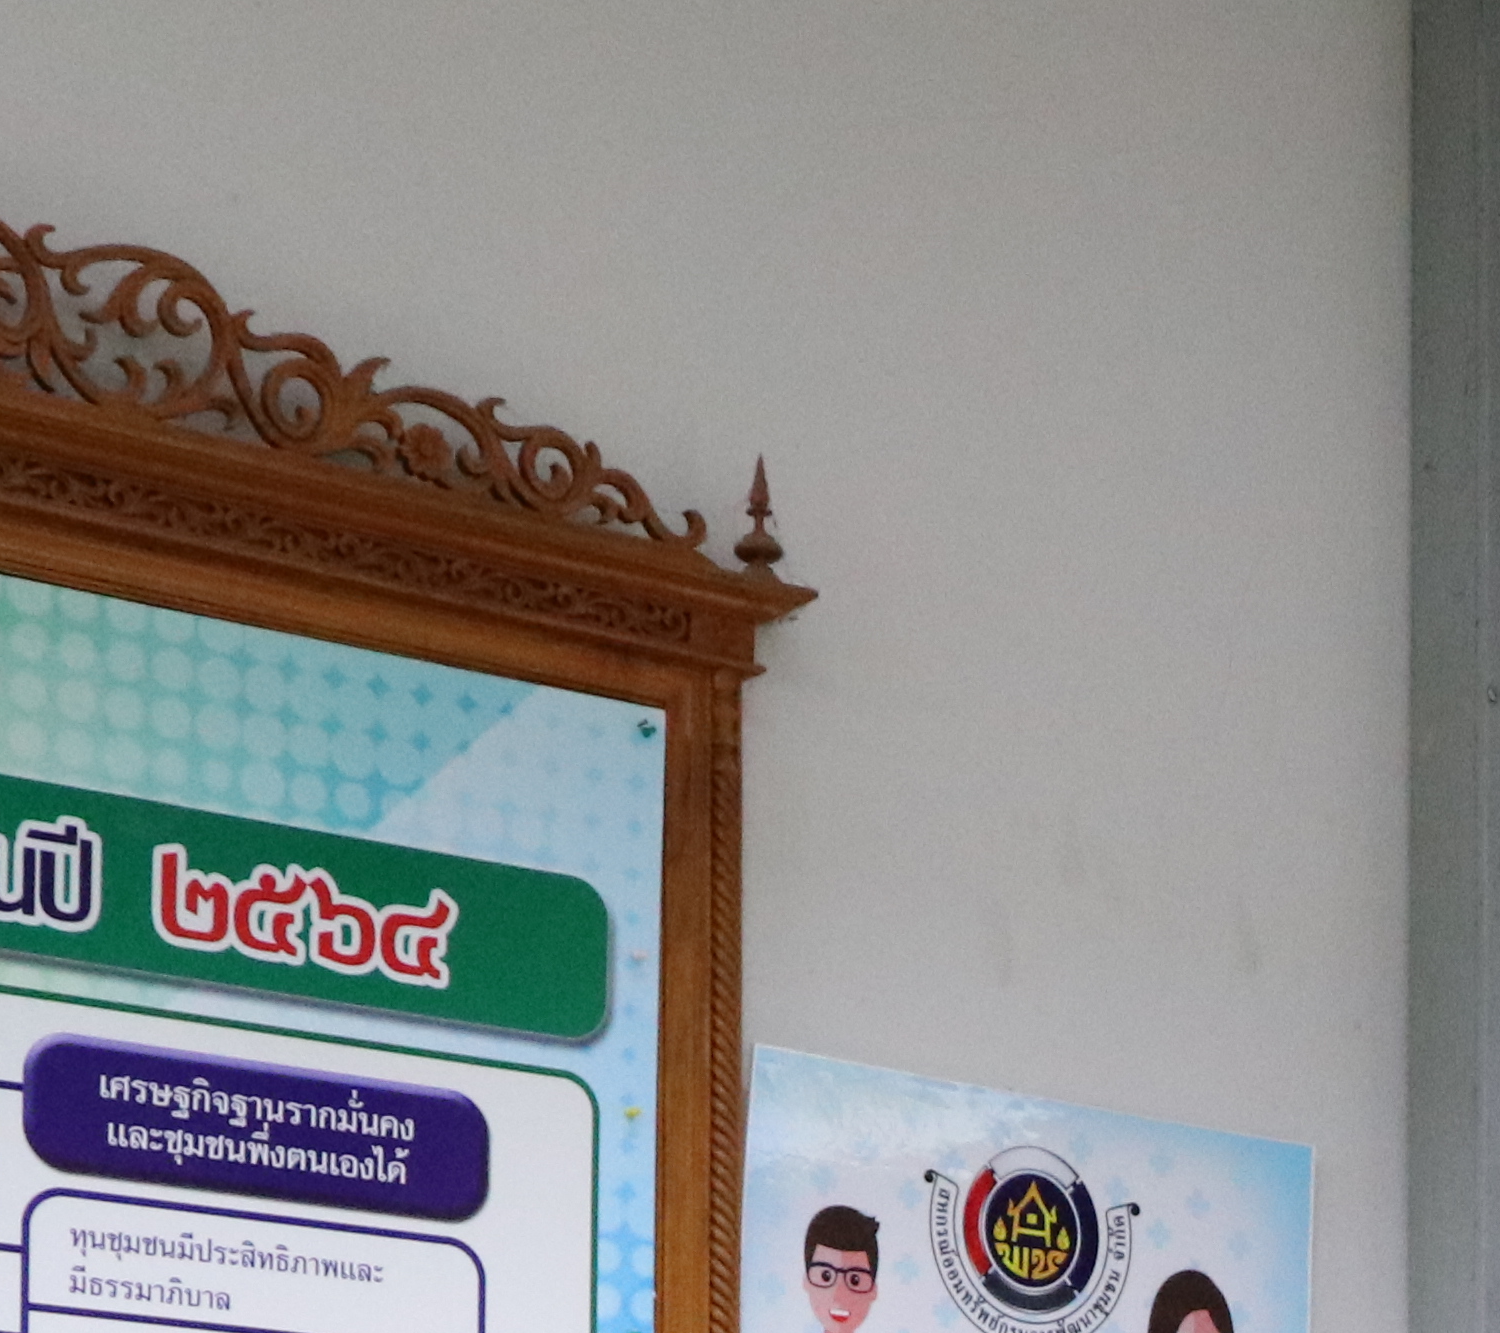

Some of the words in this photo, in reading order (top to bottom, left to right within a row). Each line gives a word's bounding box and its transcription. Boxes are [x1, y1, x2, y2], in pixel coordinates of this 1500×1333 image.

[160, 852, 451, 980] ๒๕๖๔
[99, 1074, 415, 1142] เศรษฐกิจฐานรากมั่นคง
[107, 1121, 410, 1185] และชุมชนพึ่งตนเองได้
[69, 1226, 384, 1284] ทุนชุมชนมีประสิทธิภาพและ
[68, 1265, 232, 1312] มีธรรมาภิบาล
